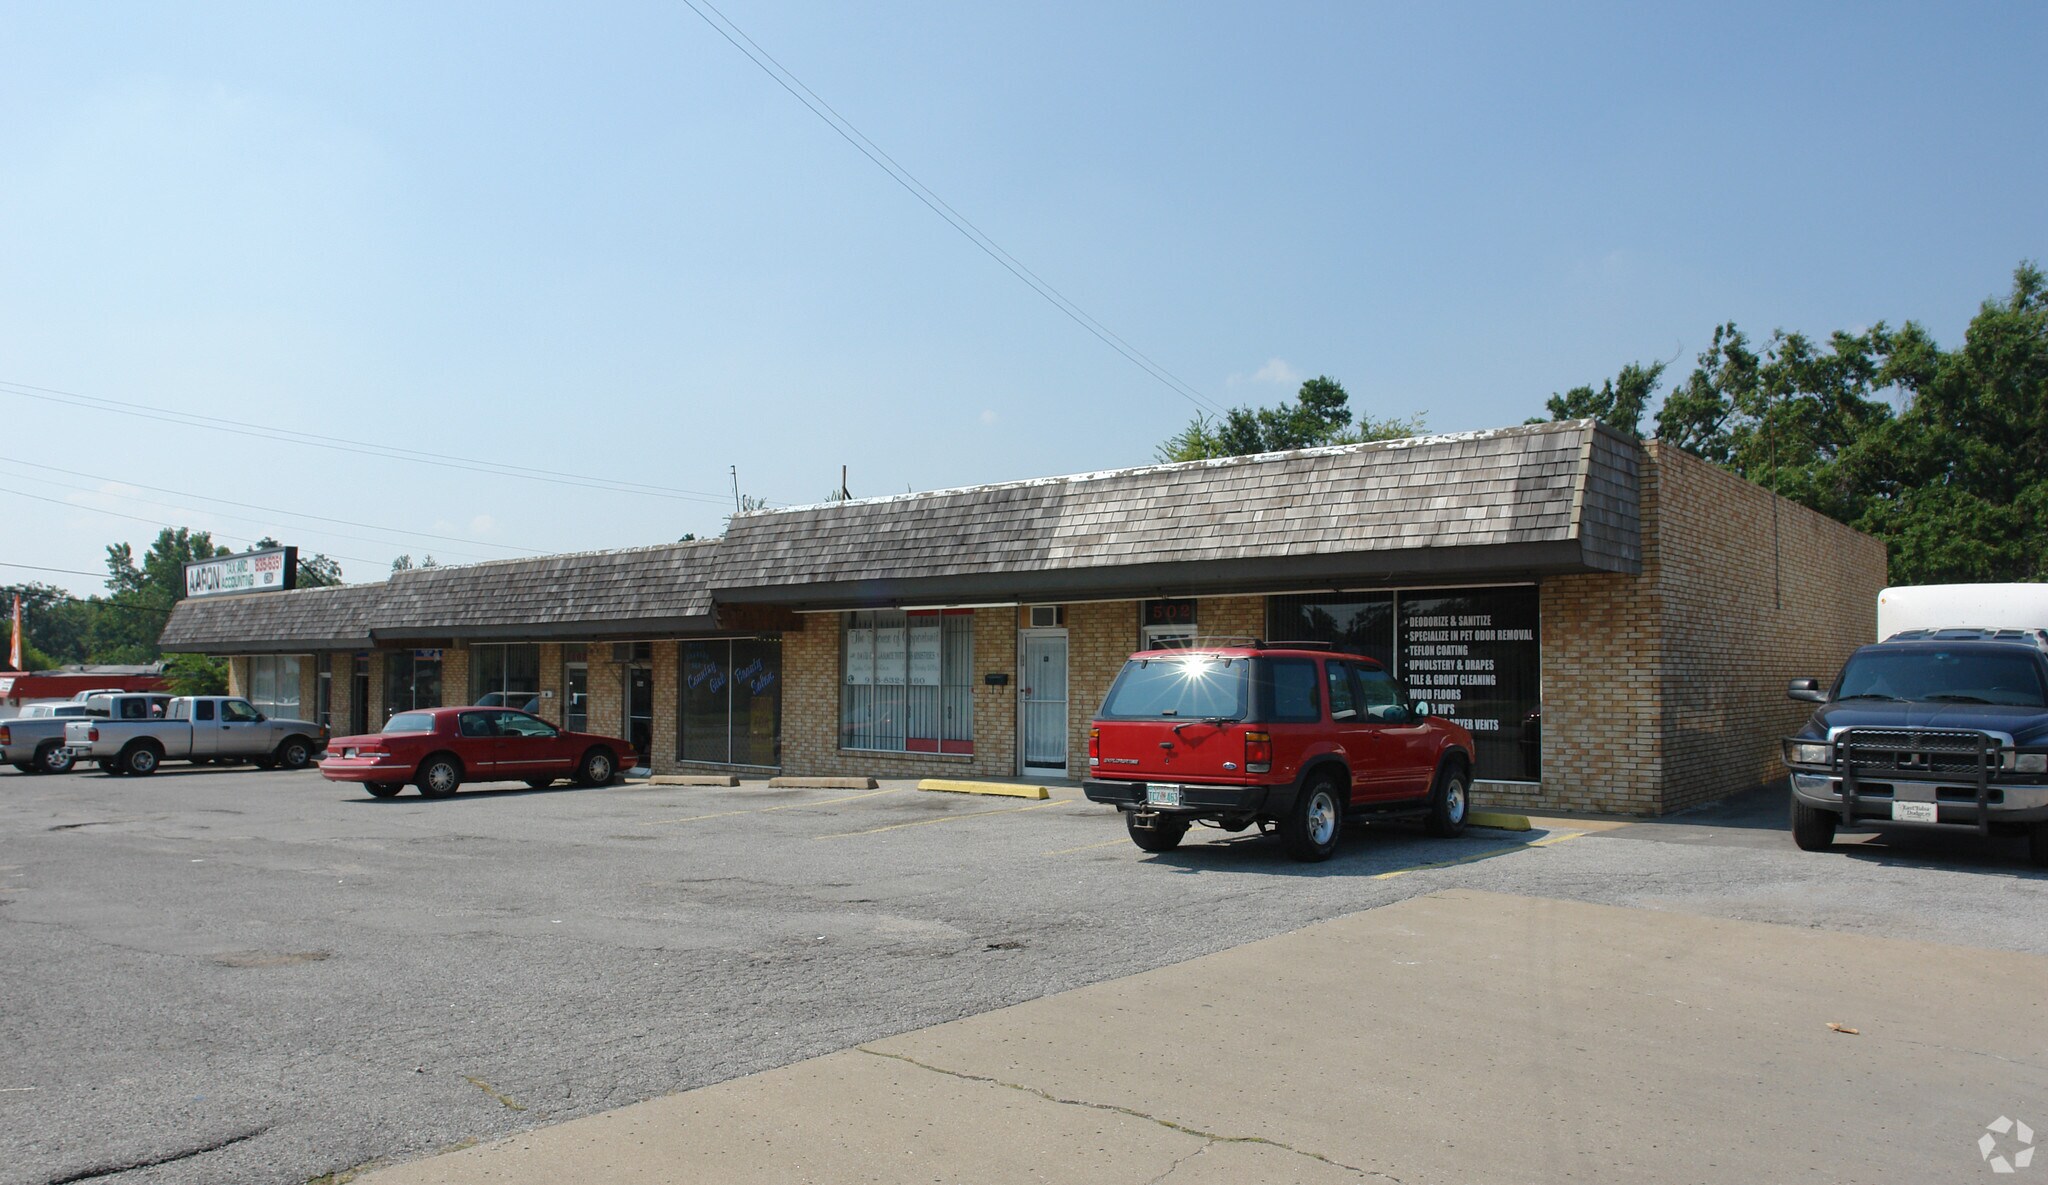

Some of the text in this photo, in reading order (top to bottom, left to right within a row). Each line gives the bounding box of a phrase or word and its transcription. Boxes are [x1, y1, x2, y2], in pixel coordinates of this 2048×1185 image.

[226, 560, 248, 574] TAX AND
[189, 565, 220, 592] AARON
[222, 574, 254, 589] ACCOUNTING
[1152, 604, 1192, 619] 502
[1409, 615, 1491, 627] DEODORIZE & SANITIZE
[1409, 629, 1533, 641] SPECIALIZE IN PET ODOR REMOVAL
[1409, 645, 1468, 656] TEFLON COATING
[1409, 659, 1494, 671] UPHOLSTERY & DRAPES
[1409, 674, 1496, 685] TILE & GROUT CLEANING
[1409, 689, 1461, 700] WOOD FLOORS
[1438, 703, 1455, 714] RV'S
[1475, 719, 1499, 731] VENTS
